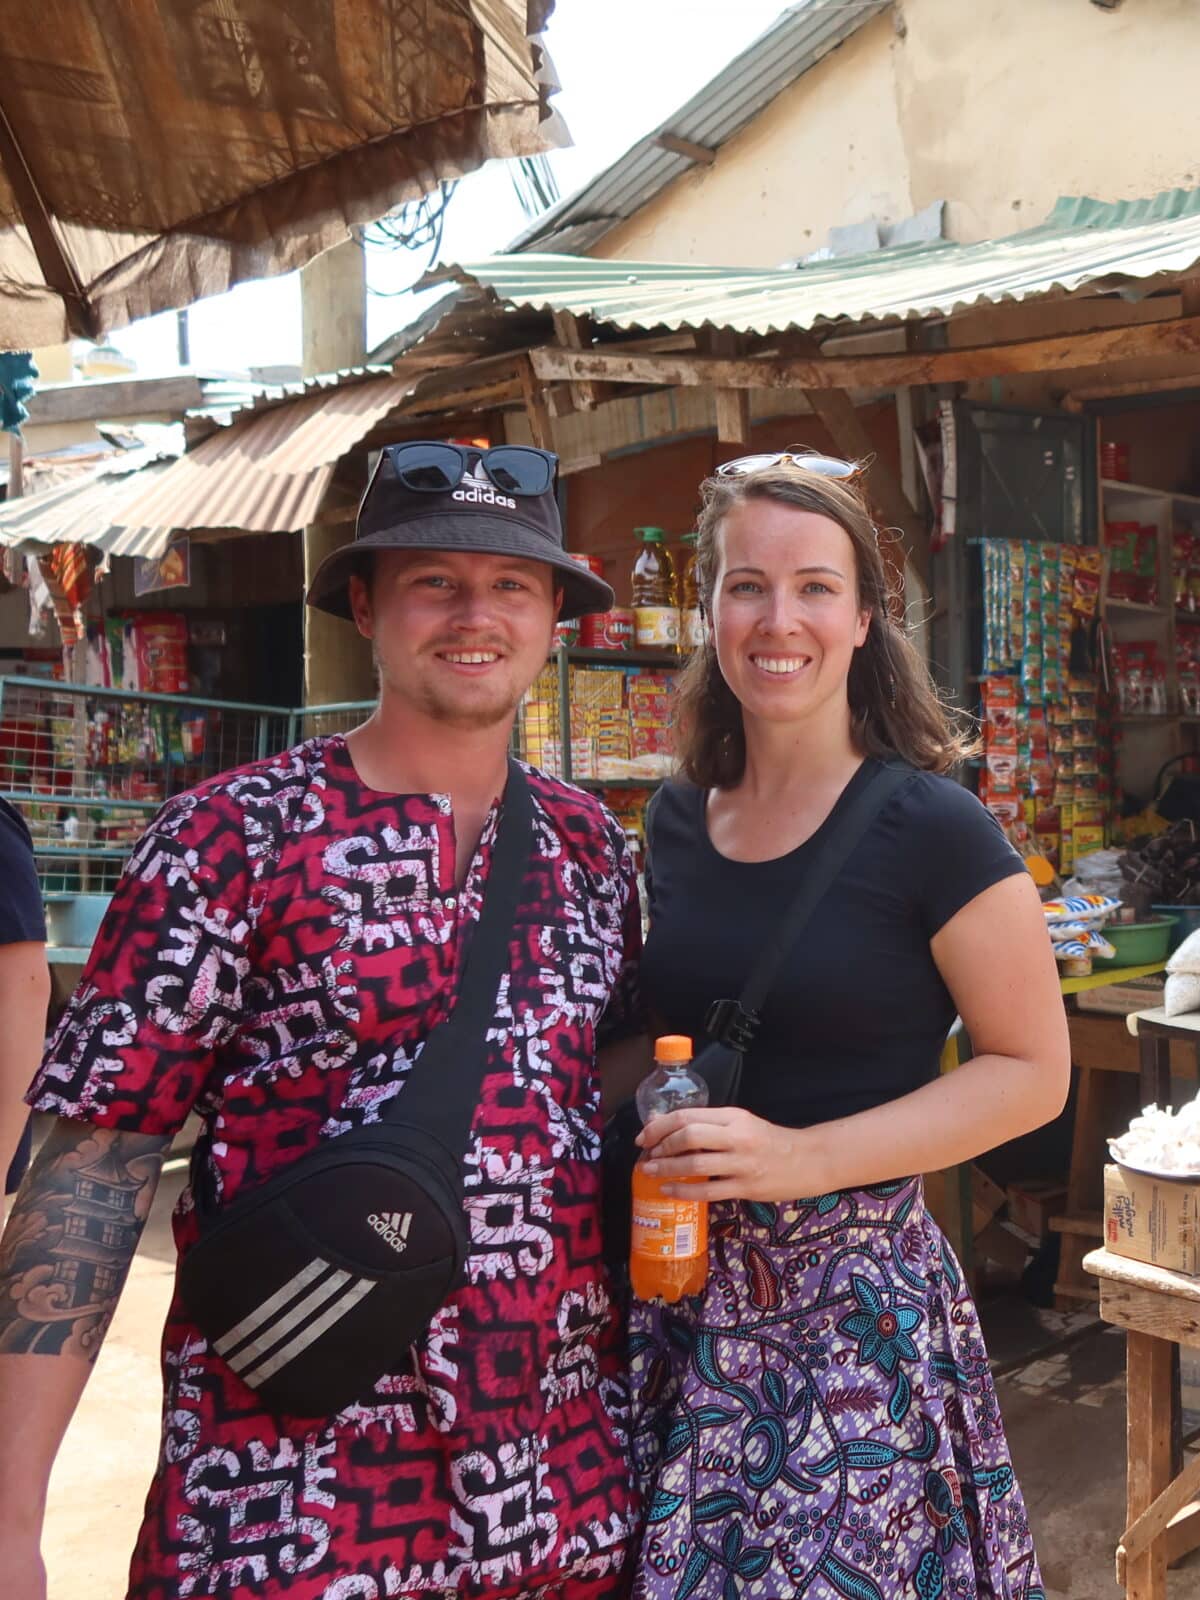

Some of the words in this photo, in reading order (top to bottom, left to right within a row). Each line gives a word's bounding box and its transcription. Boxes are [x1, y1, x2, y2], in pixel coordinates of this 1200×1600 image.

[452, 488, 517, 509] adidas
[1112, 1195, 1125, 1229] milky
[1123, 1197, 1136, 1237] magic
[367, 1214, 407, 1252] adidas
